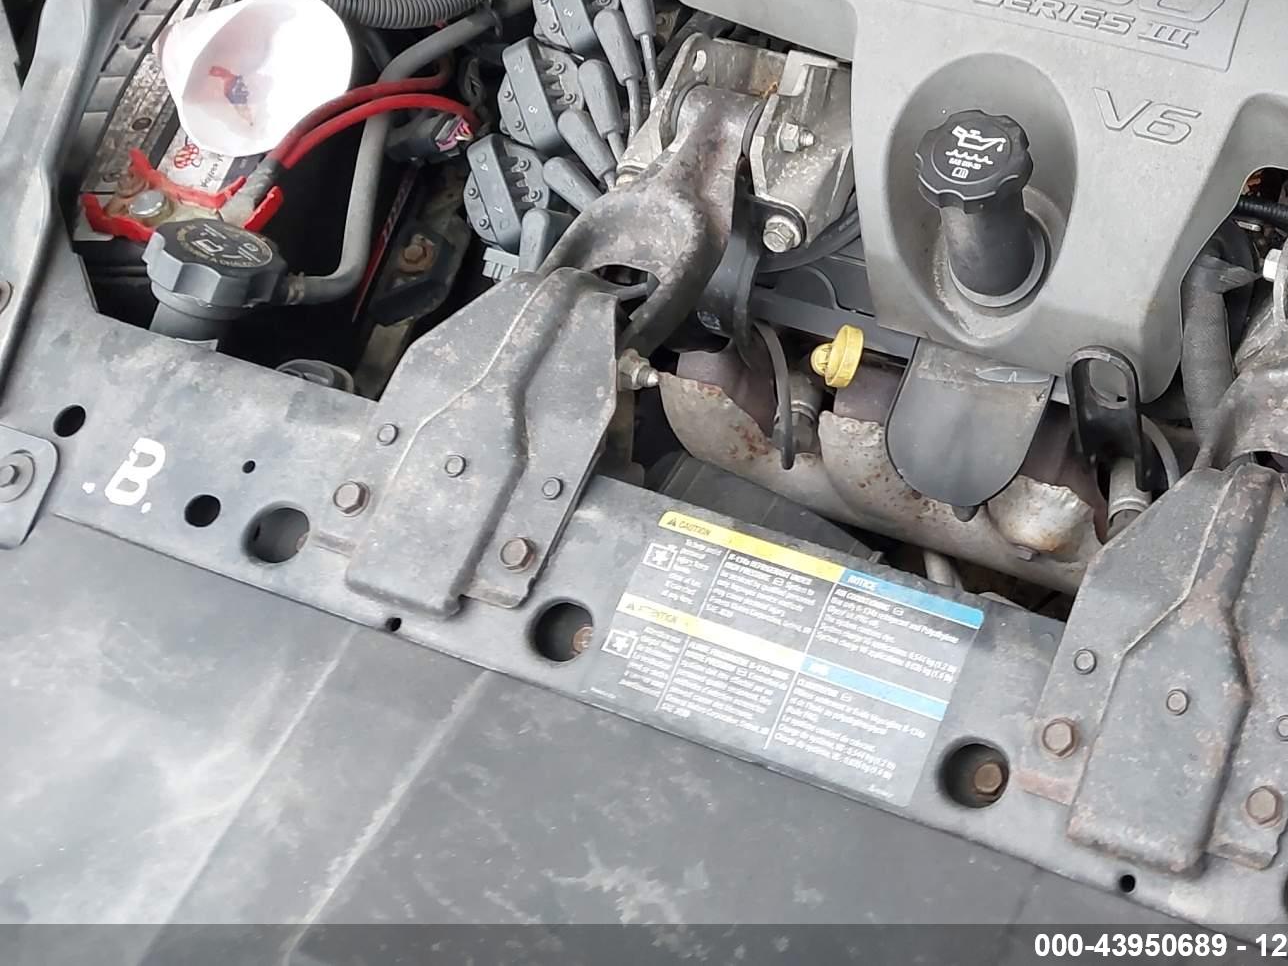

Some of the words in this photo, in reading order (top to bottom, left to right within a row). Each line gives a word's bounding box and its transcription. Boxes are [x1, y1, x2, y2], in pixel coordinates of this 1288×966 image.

[1137, 20, 1200, 50] III
[1094, 87, 1202, 145] V6
[678, 520, 711, 536] CAUTION
[847, 574, 879, 591] NOTICE
